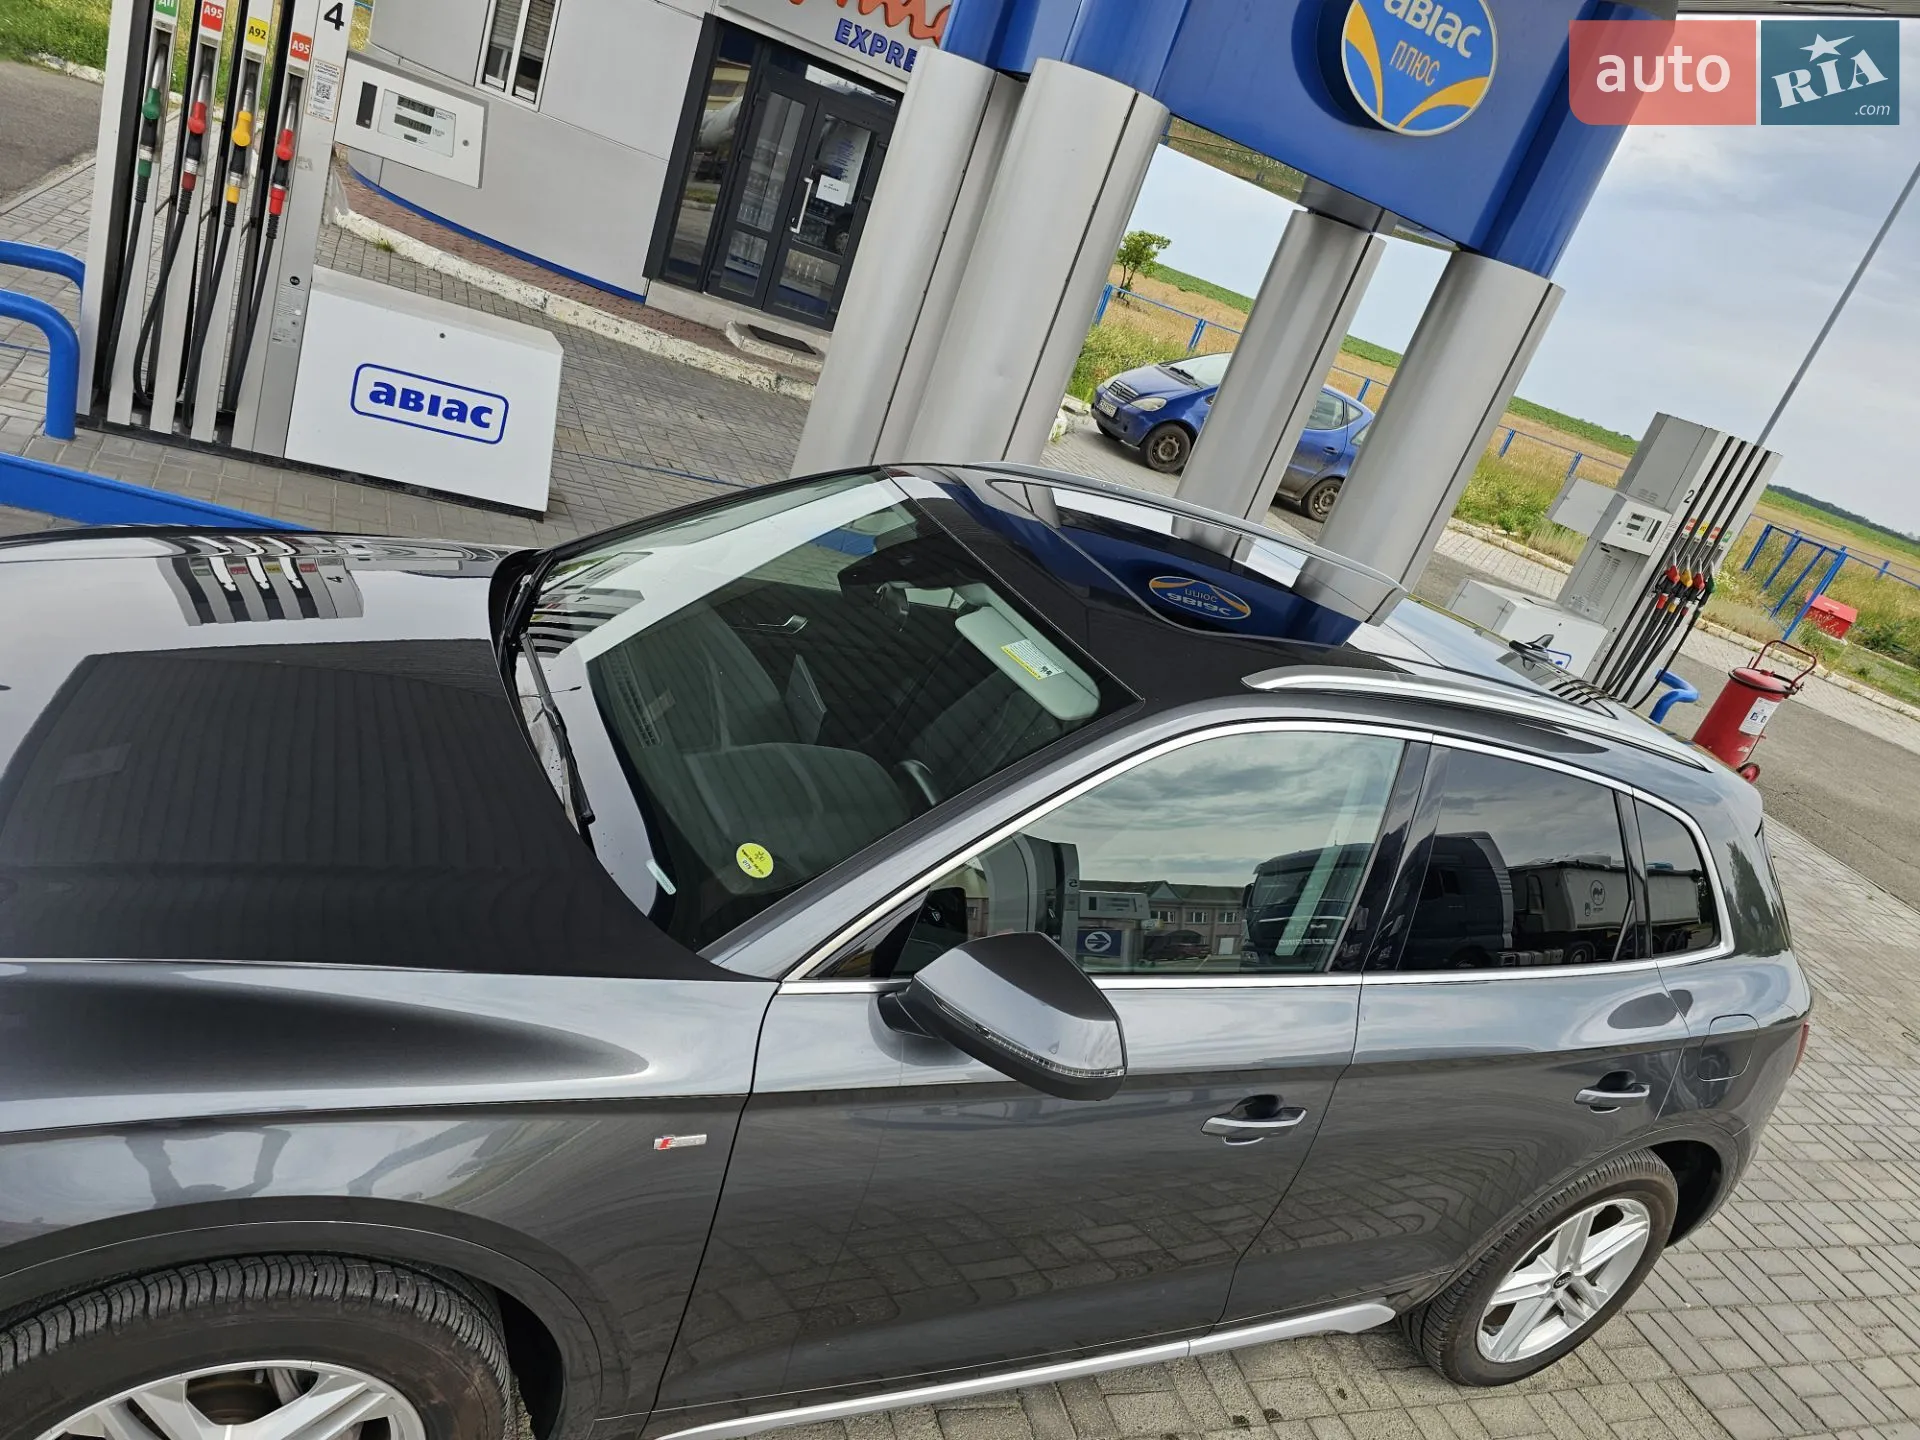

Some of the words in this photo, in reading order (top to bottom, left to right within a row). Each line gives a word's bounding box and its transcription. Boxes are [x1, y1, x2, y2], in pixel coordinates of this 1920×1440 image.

[324, 2, 345, 31] 4
[1389, 40, 1440, 86] ПЛЮС
[1683, 489, 1695, 504] 2
